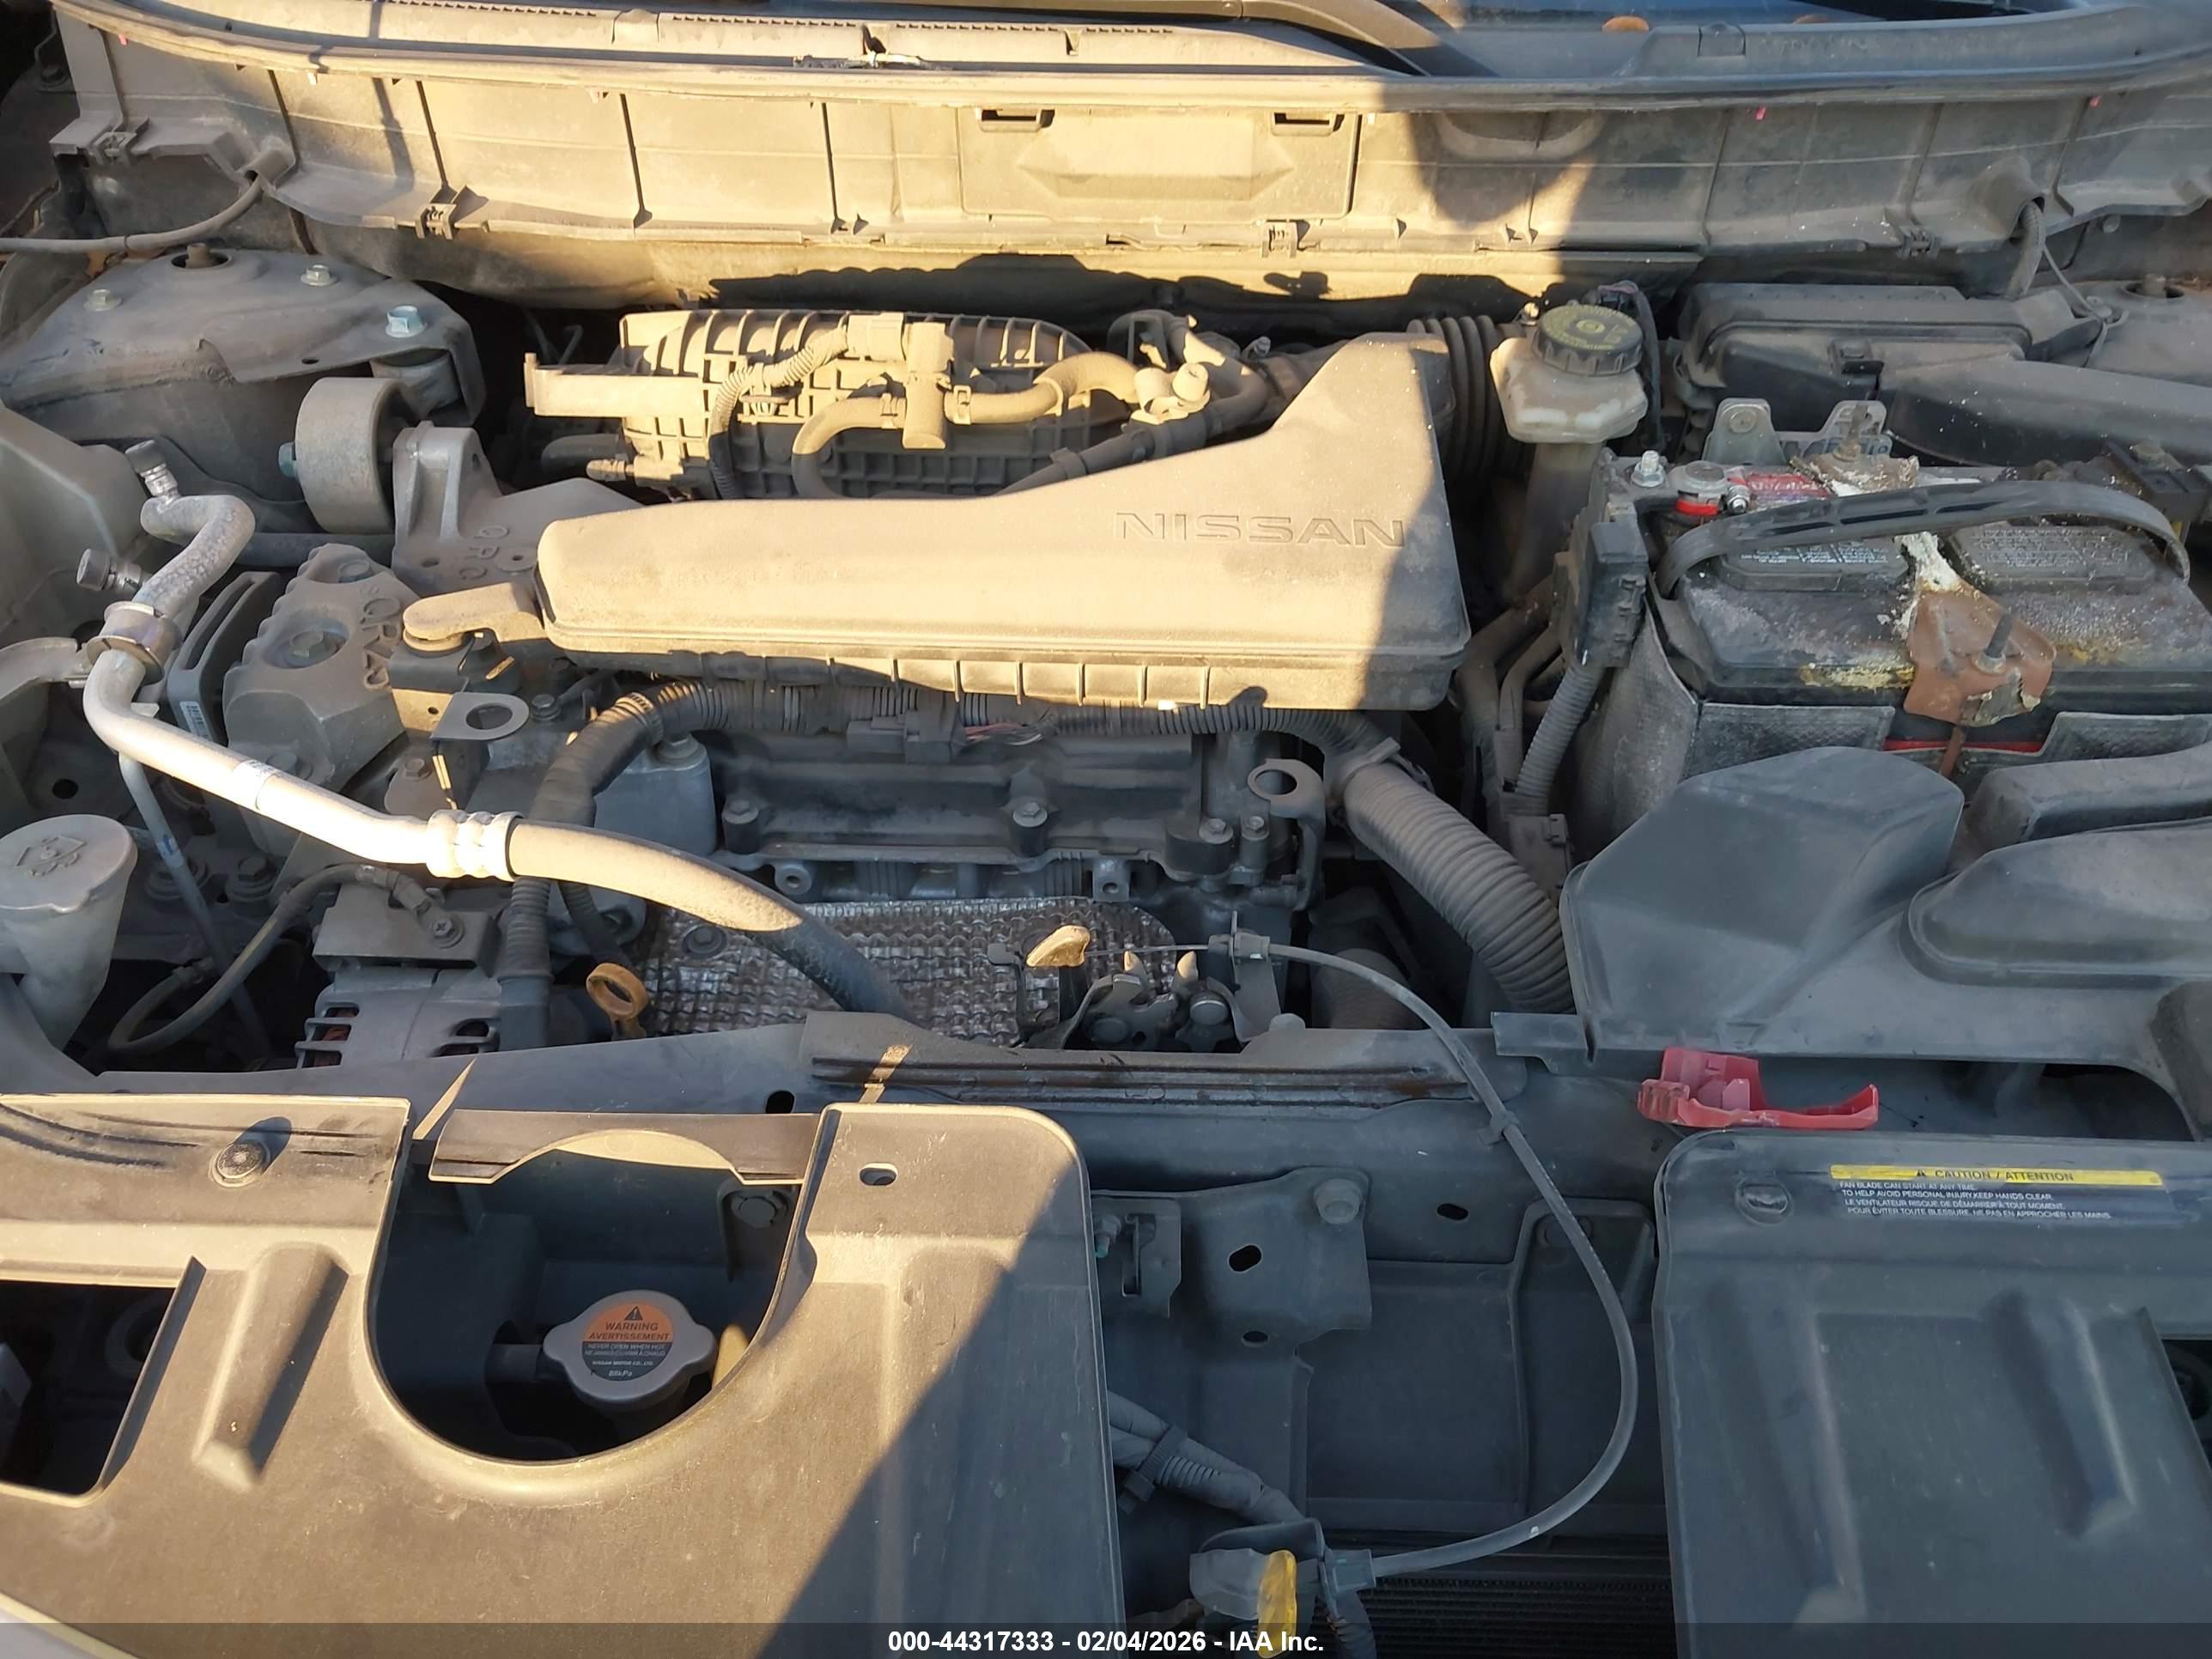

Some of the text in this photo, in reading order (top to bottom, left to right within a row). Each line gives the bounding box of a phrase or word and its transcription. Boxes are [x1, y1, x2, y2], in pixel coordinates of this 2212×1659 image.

[1115, 512, 1407, 547] NISSAN
[1935, 1170, 1990, 1179] CAUTION
[2005, 1171, 2075, 1182] ATTENTION
[1995, 1192, 2024, 1200] HANDS
[2025, 1193, 2054, 1201] CLEAR.
[2016, 1210, 2067, 1218] APPROCHER
[605, 1322, 659, 1331] WARNING
[589, 1332, 670, 1340] AVERTISSEMENT
